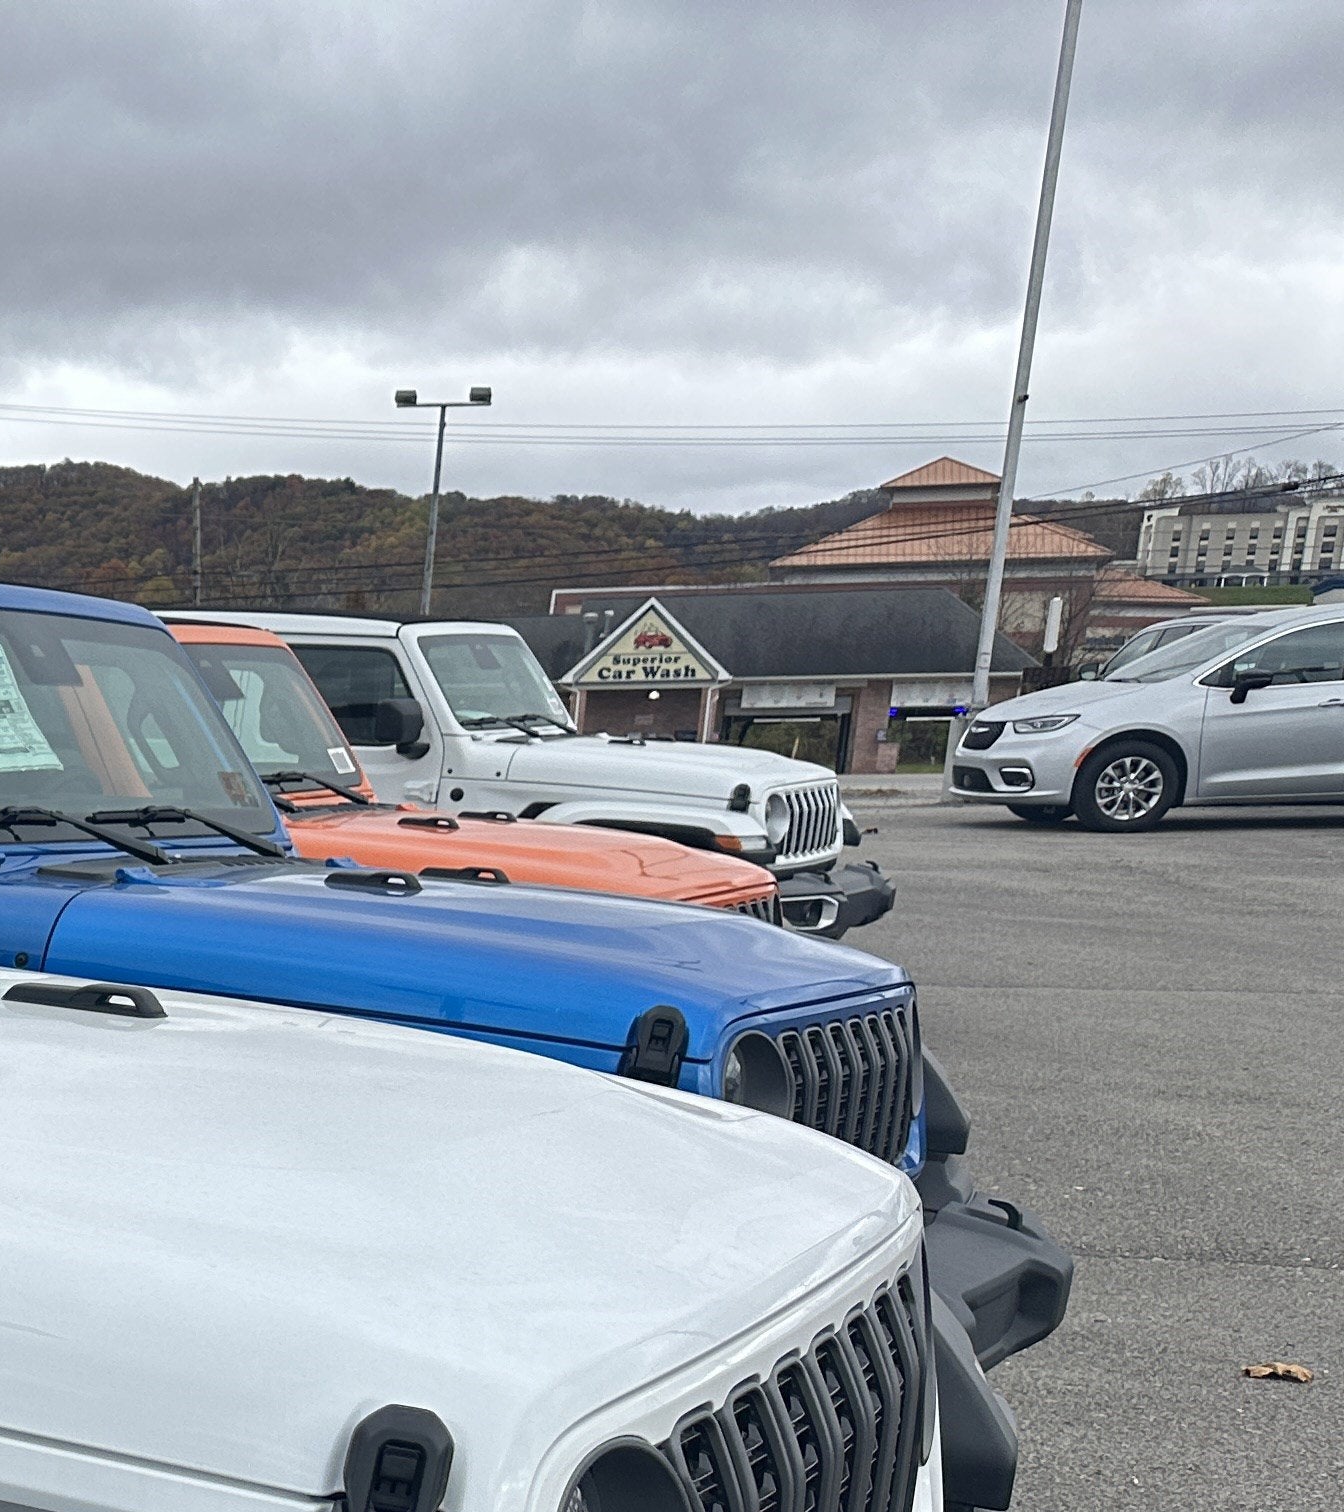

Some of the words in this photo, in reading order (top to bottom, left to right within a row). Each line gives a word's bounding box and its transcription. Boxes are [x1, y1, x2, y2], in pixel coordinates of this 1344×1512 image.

[613, 655, 681, 666] Superior
[598, 668, 637, 680] Car
[643, 665, 696, 679] Wash
